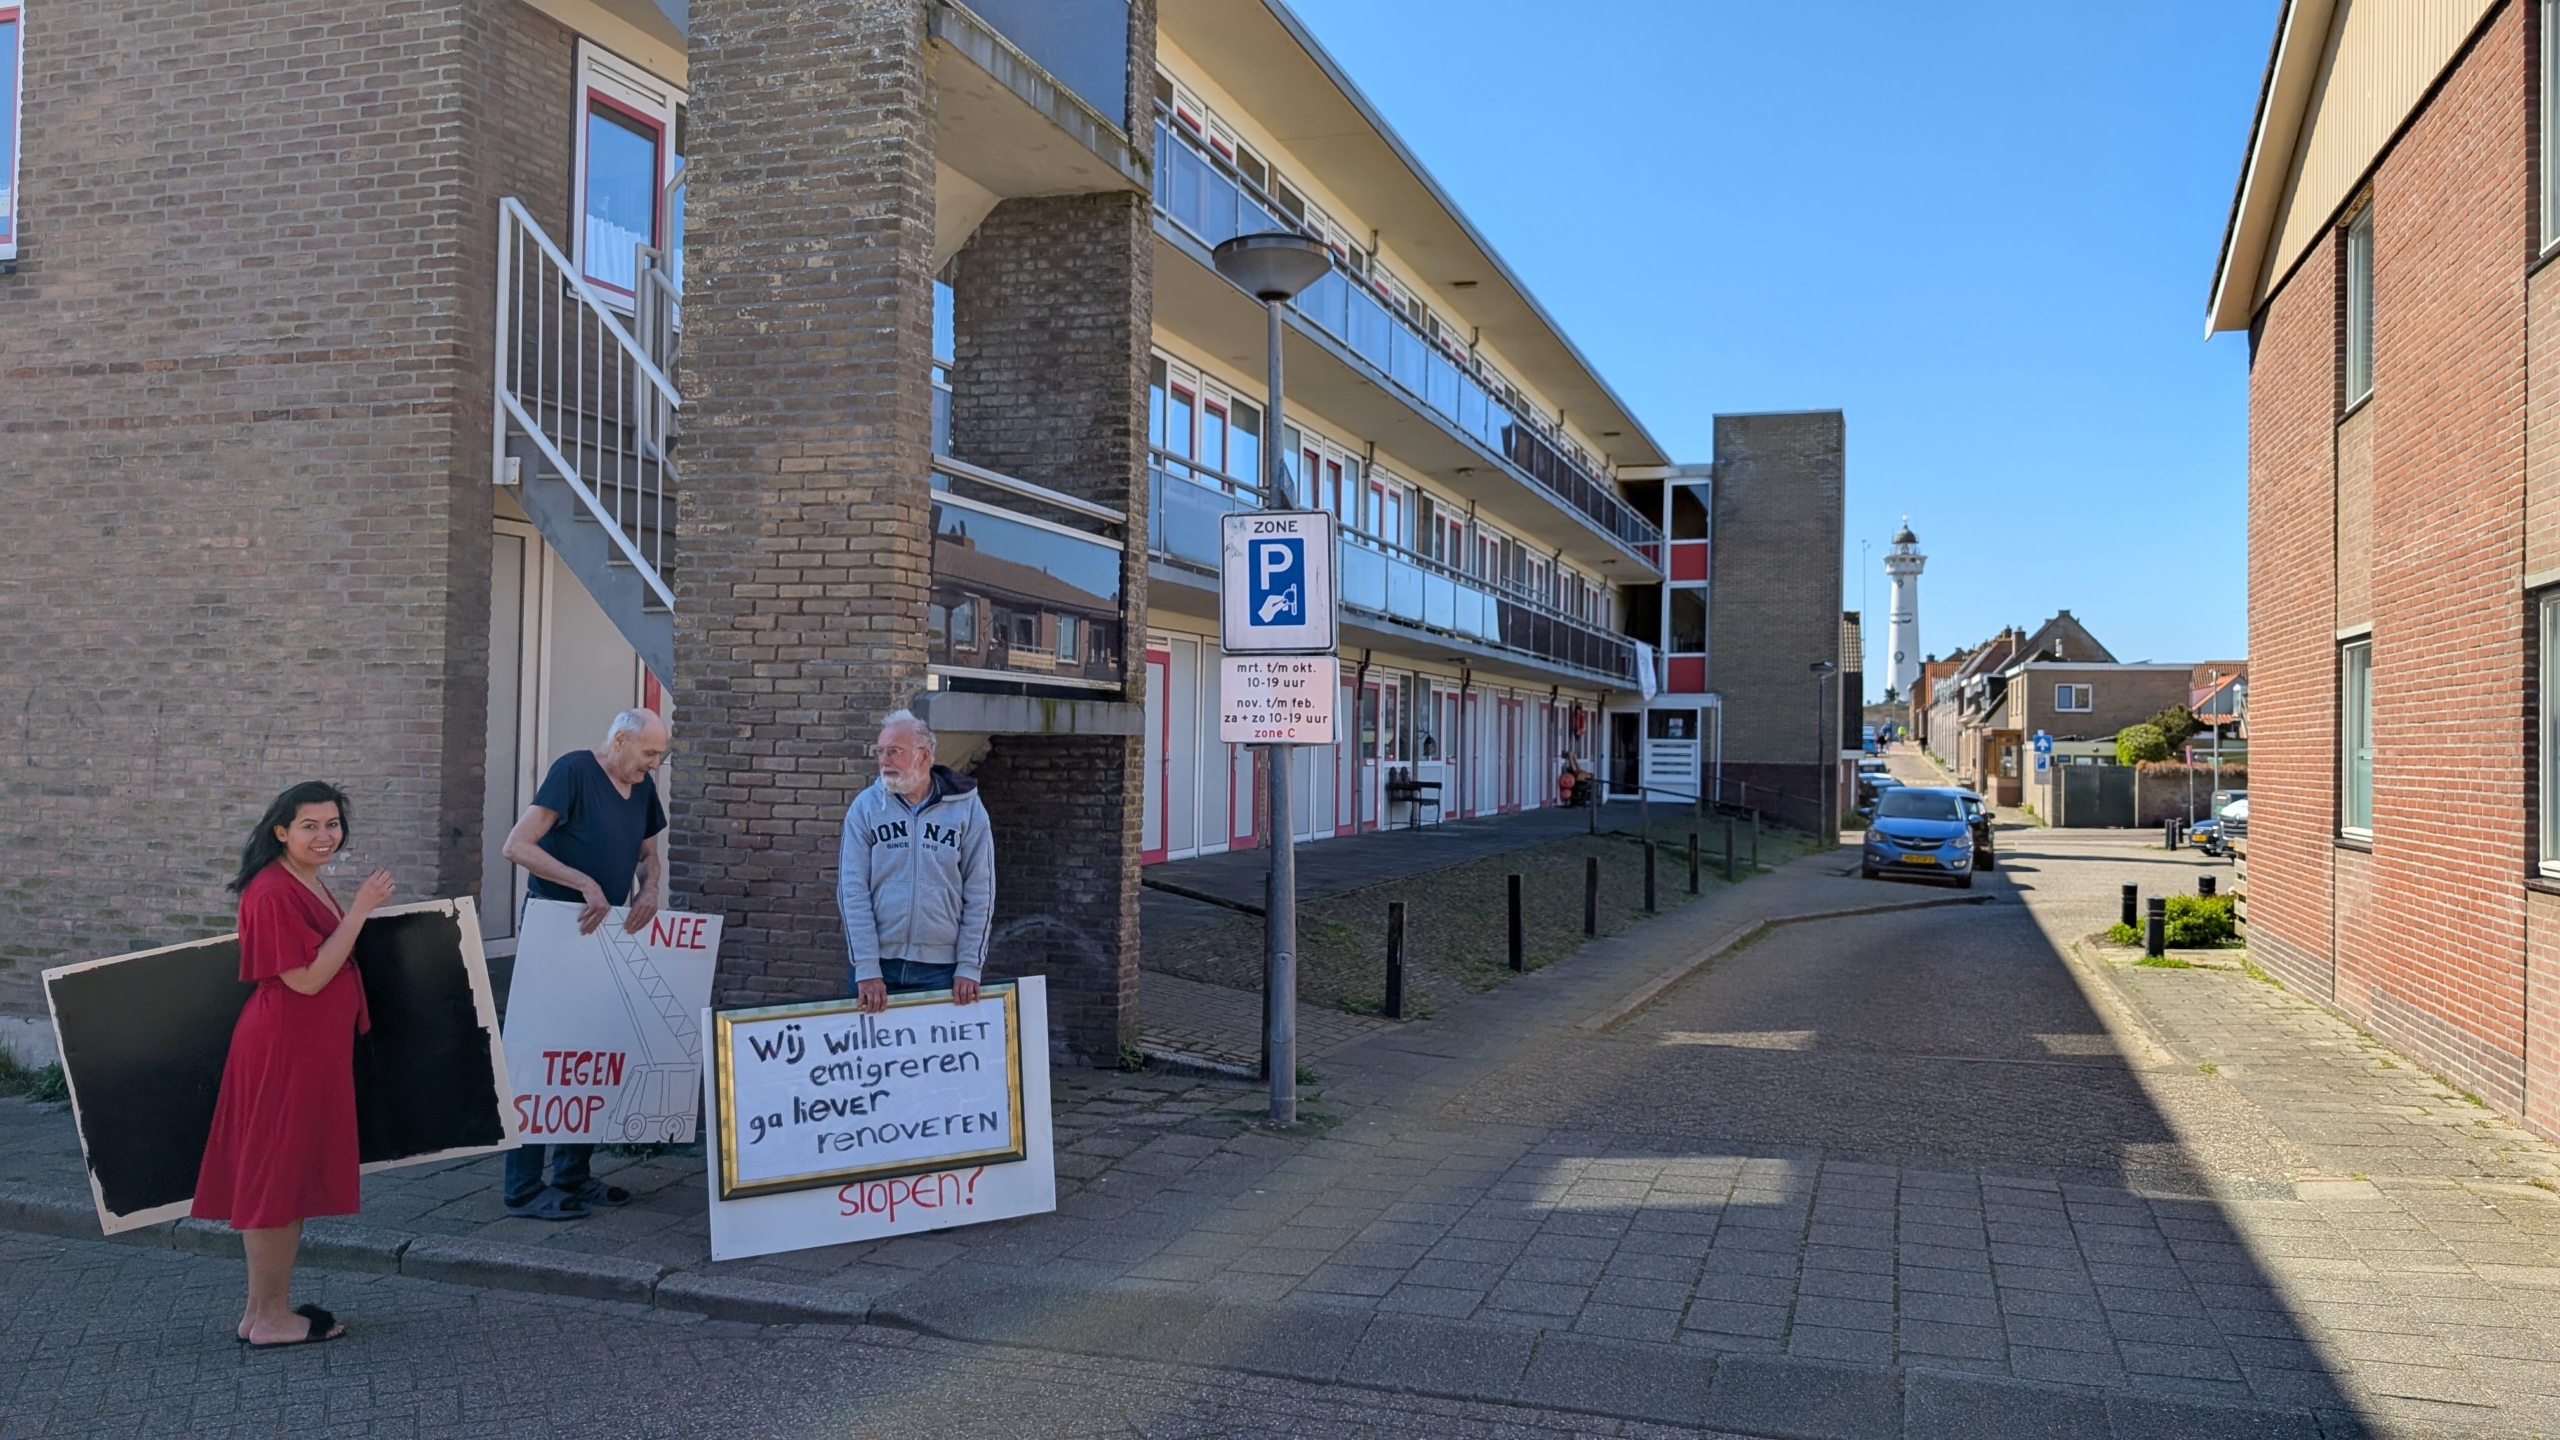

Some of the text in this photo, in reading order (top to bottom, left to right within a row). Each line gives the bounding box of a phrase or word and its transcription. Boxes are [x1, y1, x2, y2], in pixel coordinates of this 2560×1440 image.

[1253, 520, 1298, 534] ZONE
[1260, 543, 1293, 590] P
[1237, 661, 1316, 674] mrt. t/m okt.
[1247, 677, 1305, 688] 10-19 uur
[1224, 712, 1328, 724] za + zo 10-19 uur
[1237, 697, 1315, 709] nov. t/m feb.
[1254, 728, 1296, 738] zone C
[886, 842, 910, 850] SINCE
[923, 822, 962, 852] NA
[650, 915, 707, 950] NEE
[748, 1024, 806, 1065] Wij
[823, 1013, 916, 1056] willen
[542, 1051, 626, 1087] TEGEN
[809, 1050, 980, 1088] emigreren
[513, 1094, 605, 1134] SLOOP
[749, 1112, 783, 1145] ga
